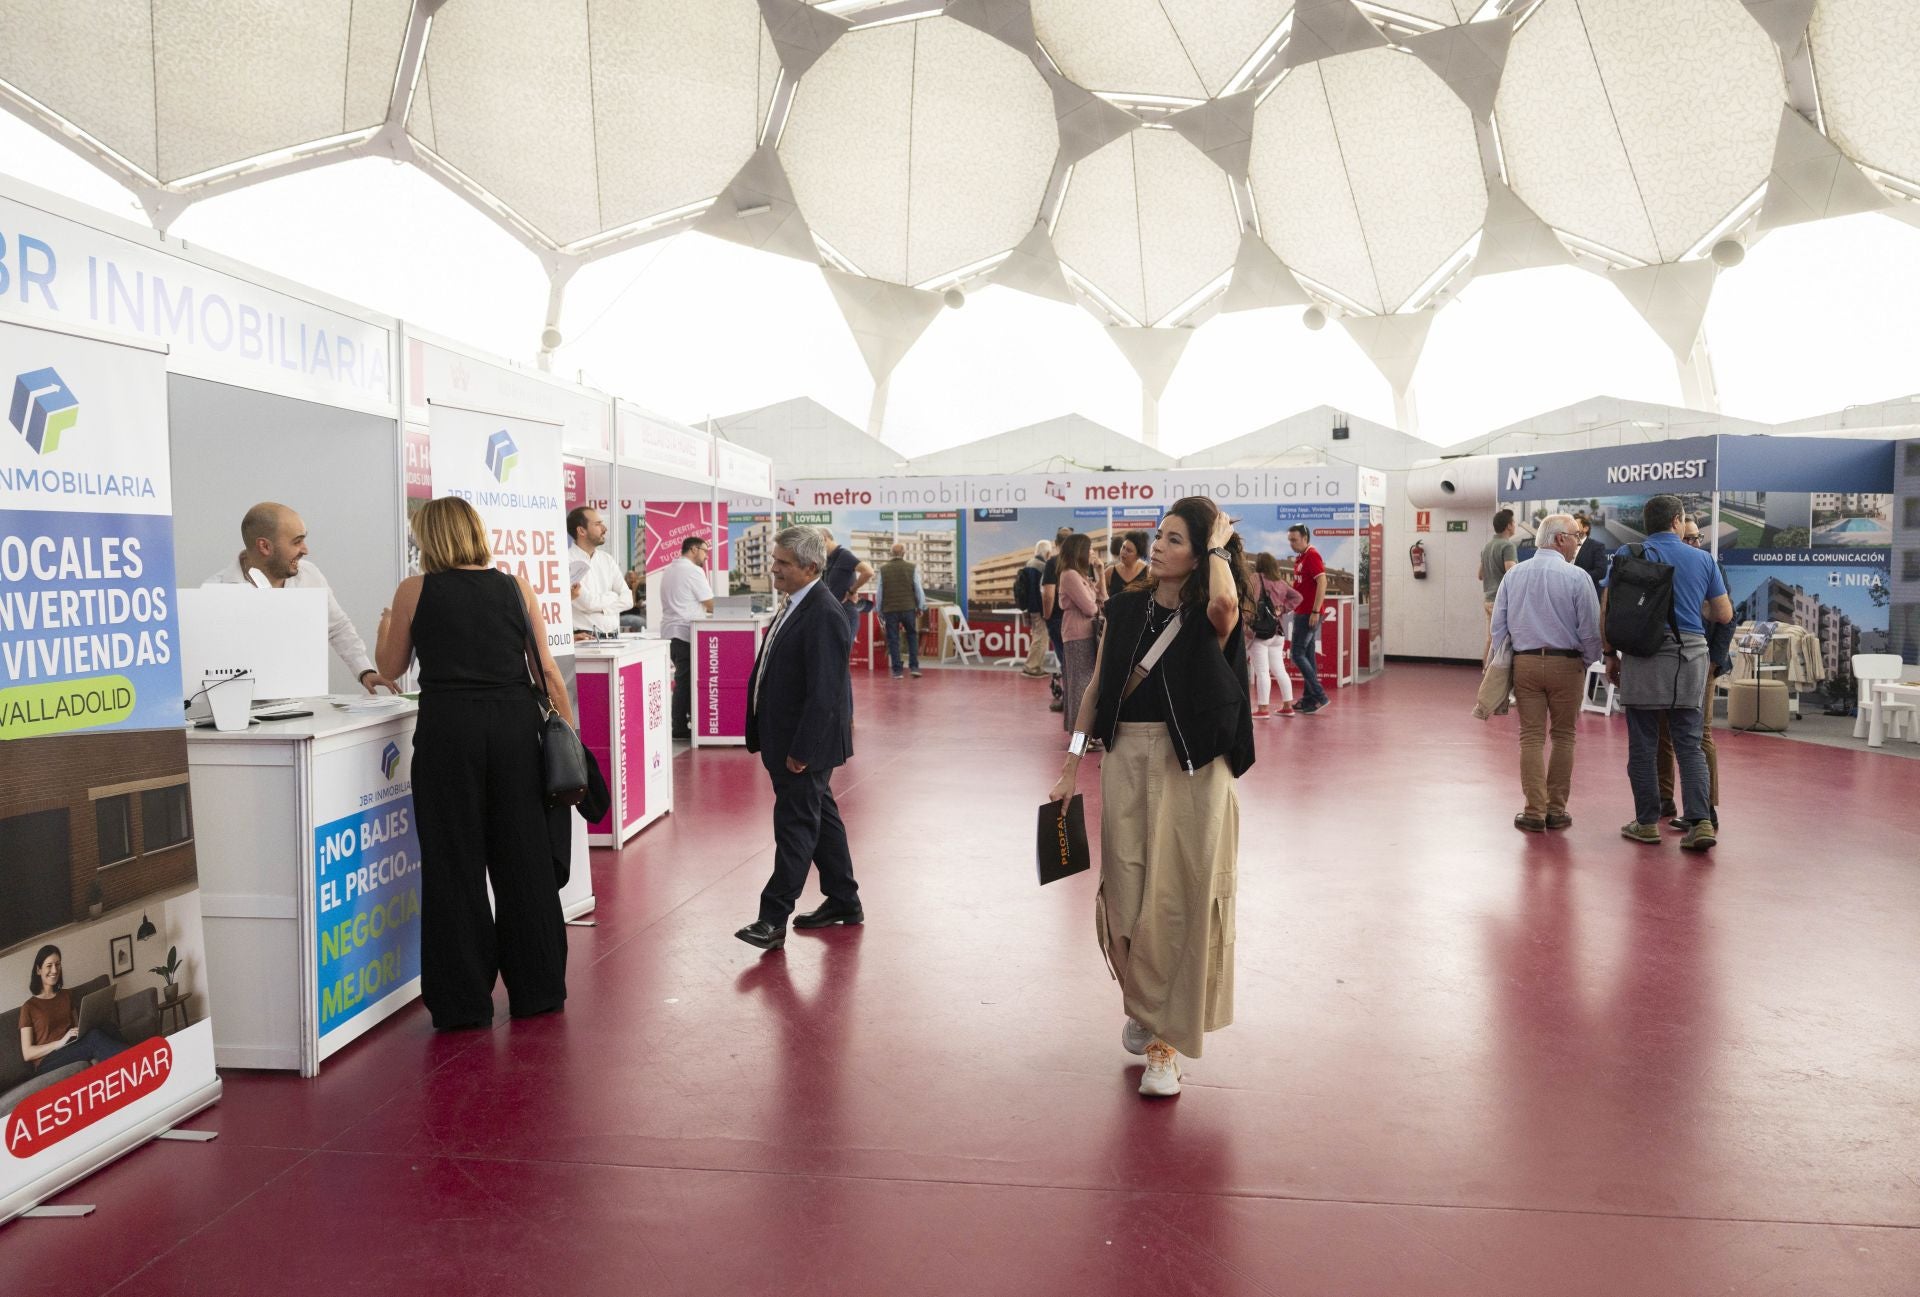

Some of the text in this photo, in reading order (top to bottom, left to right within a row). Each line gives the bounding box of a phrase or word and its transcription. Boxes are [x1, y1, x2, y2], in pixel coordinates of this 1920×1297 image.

[88, 255, 388, 390] INMOBILIARIA
[0, 467, 156, 498] NMOBILIARIA
[1085, 480, 1154, 501] metro
[1163, 473, 1341, 500] inmobiliaria
[1506, 458, 1708, 491] NF NORFOREST
[475, 491, 558, 510] INMOBILIARIA
[814, 488, 872, 505] metro
[879, 481, 1027, 505] inmobiliaria
[668, 523, 696, 537] OFERTA
[691, 527, 712, 538] FERIA
[795, 514, 821, 524] LOYRA
[0, 535, 143, 582] OCALES
[490, 529, 556, 556] ZAS DE
[1753, 550, 1885, 562] CIUDAD DE LA COMUNICACIÓN
[1845, 573, 1882, 587] NIRA
[0, 586, 168, 632] NVERTIDOS
[2, 629, 171, 681] VIVIENDAS
[709, 636, 719, 735] BELLAVISTA HOMES
[620, 733, 628, 821] BELLAVISTA
[359, 781, 412, 807] JBR INMOBILIA
[319, 807, 409, 876] ¡NO BAJES
[320, 850, 422, 914] EL PRECIO...
[321, 887, 421, 967] NEGOCIA
[321, 943, 401, 1025] MEJOR!
[11, 1047, 171, 1151] A ESTRENAR
